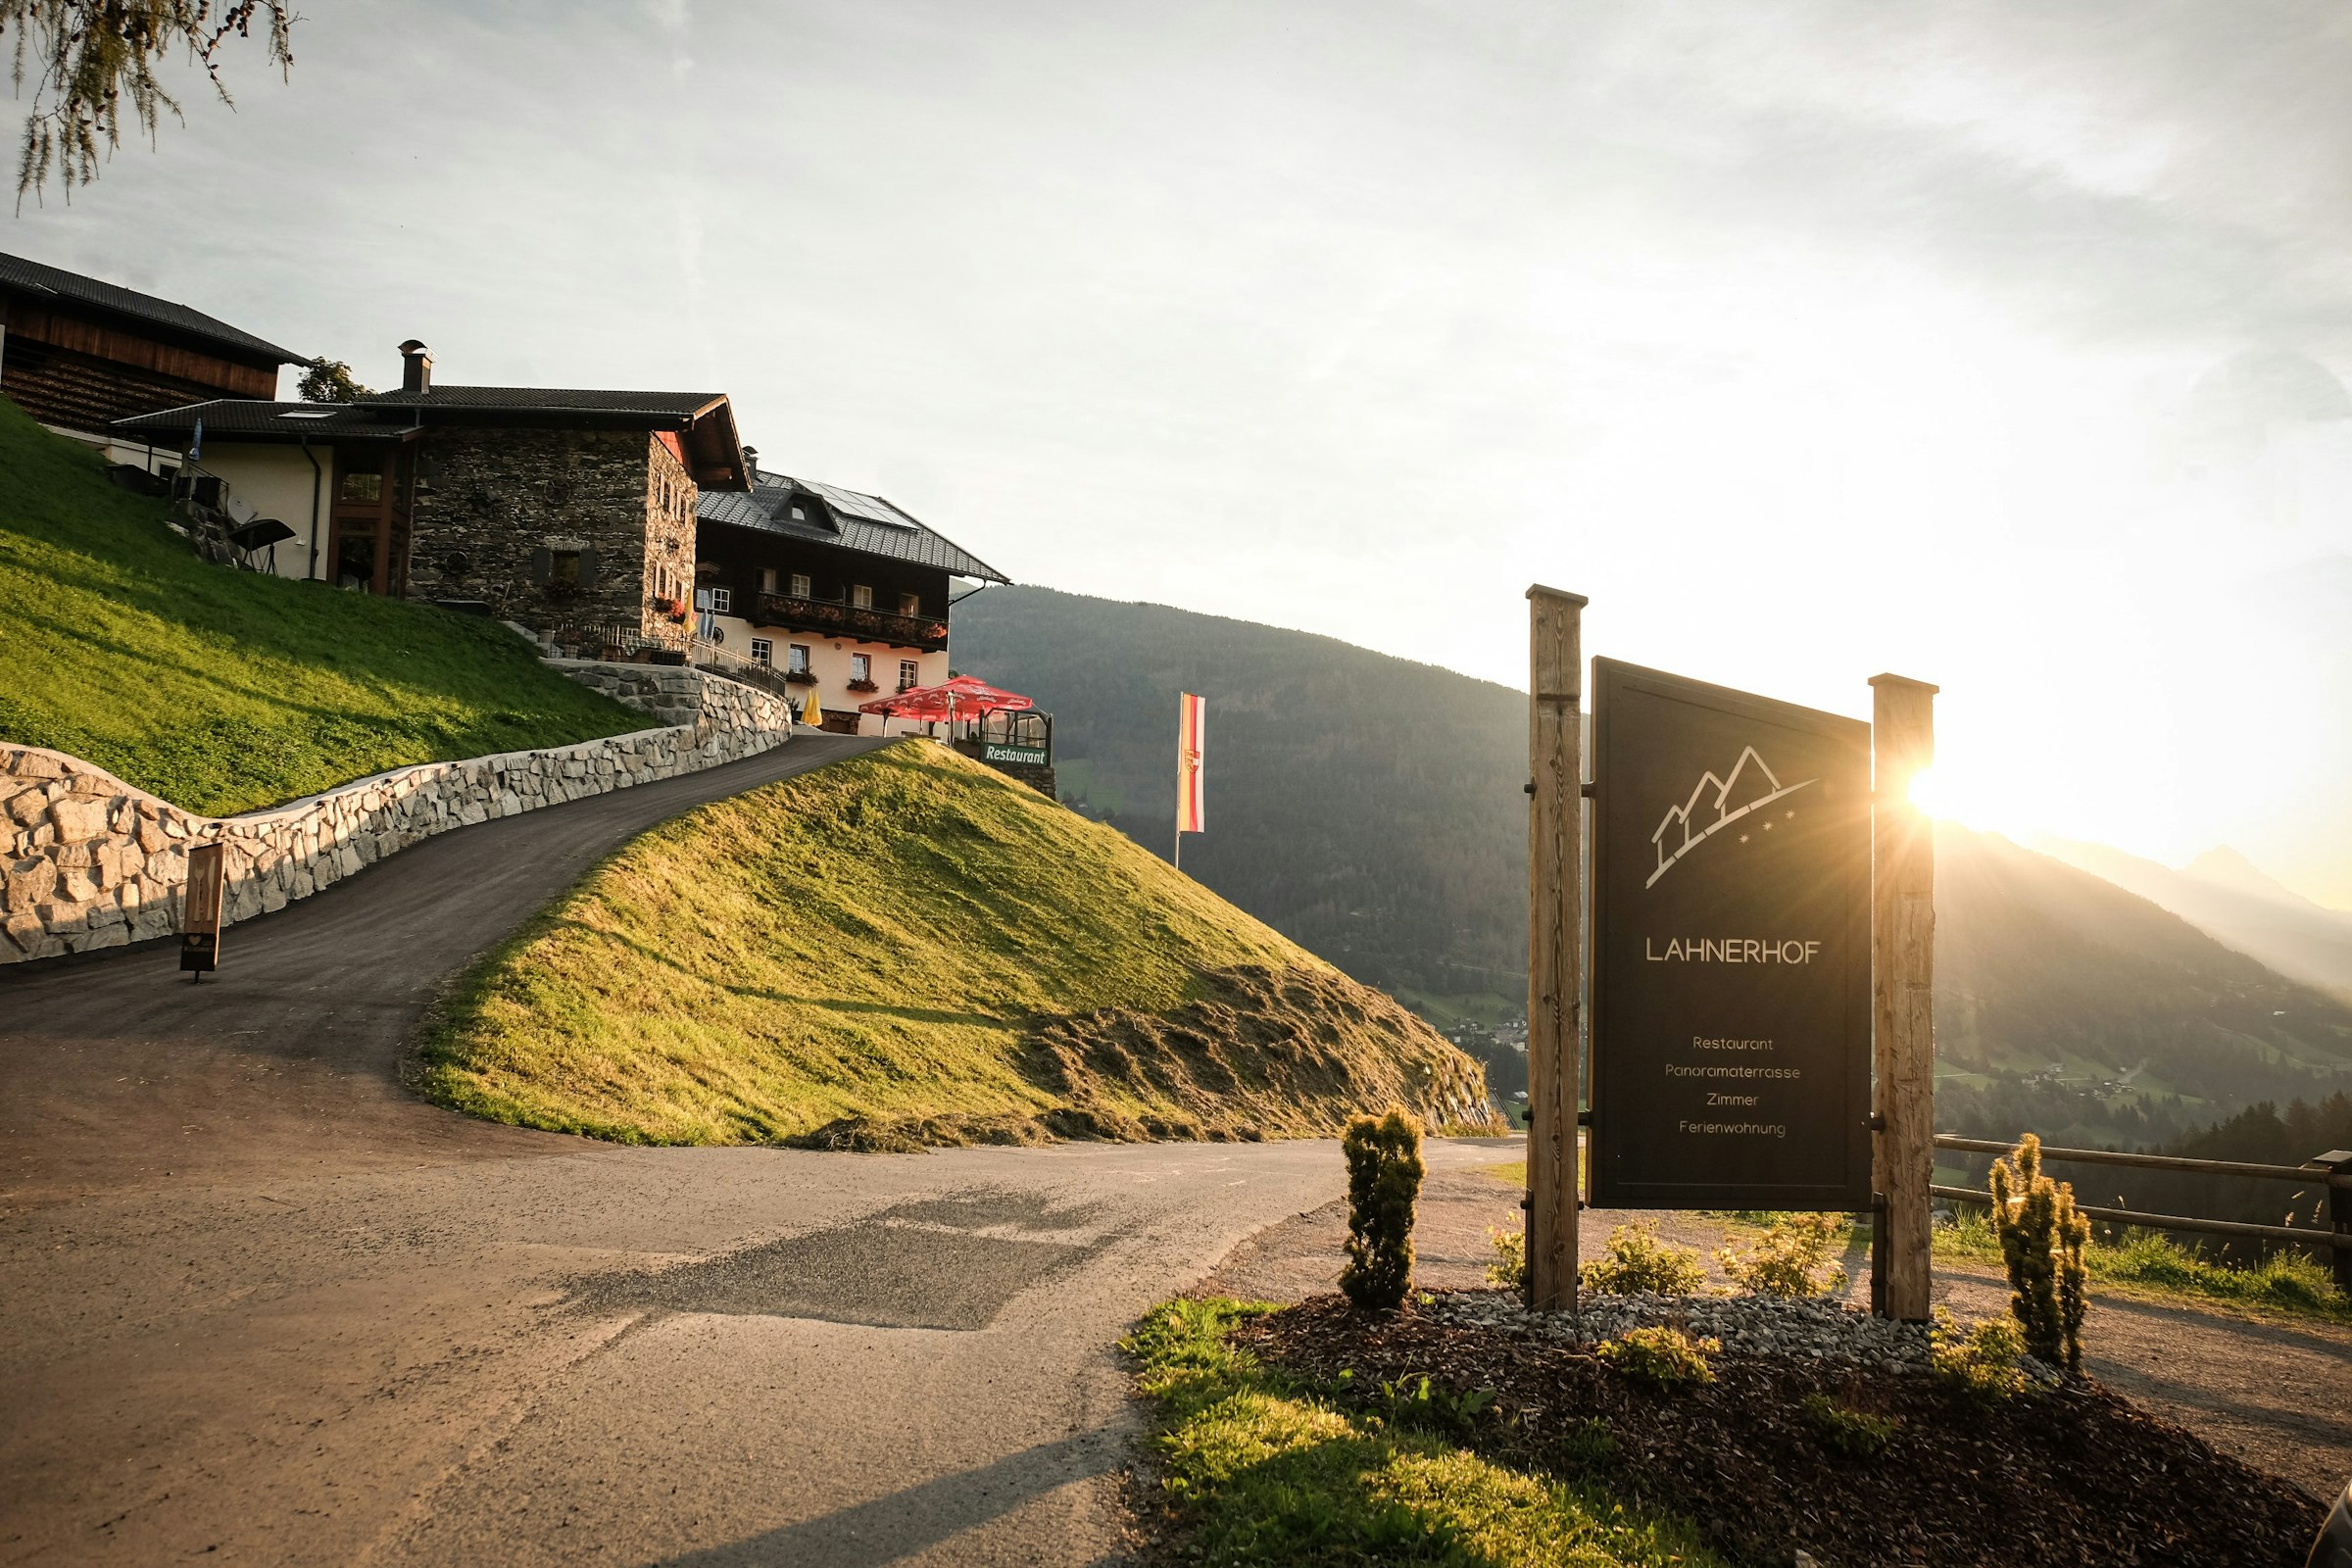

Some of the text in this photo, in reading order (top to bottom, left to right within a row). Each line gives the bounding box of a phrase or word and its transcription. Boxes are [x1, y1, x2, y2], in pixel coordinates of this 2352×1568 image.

[986, 746, 1046, 764] Restaurant
[1645, 937, 1822, 964] LAHNERHOF
[1692, 1036, 1774, 1051] Restaurant
[1666, 1063, 1801, 1079] Panoramaterrasse
[1706, 1092, 1760, 1106] Zimmer
[1679, 1120, 1786, 1138] Ferienwohnung
